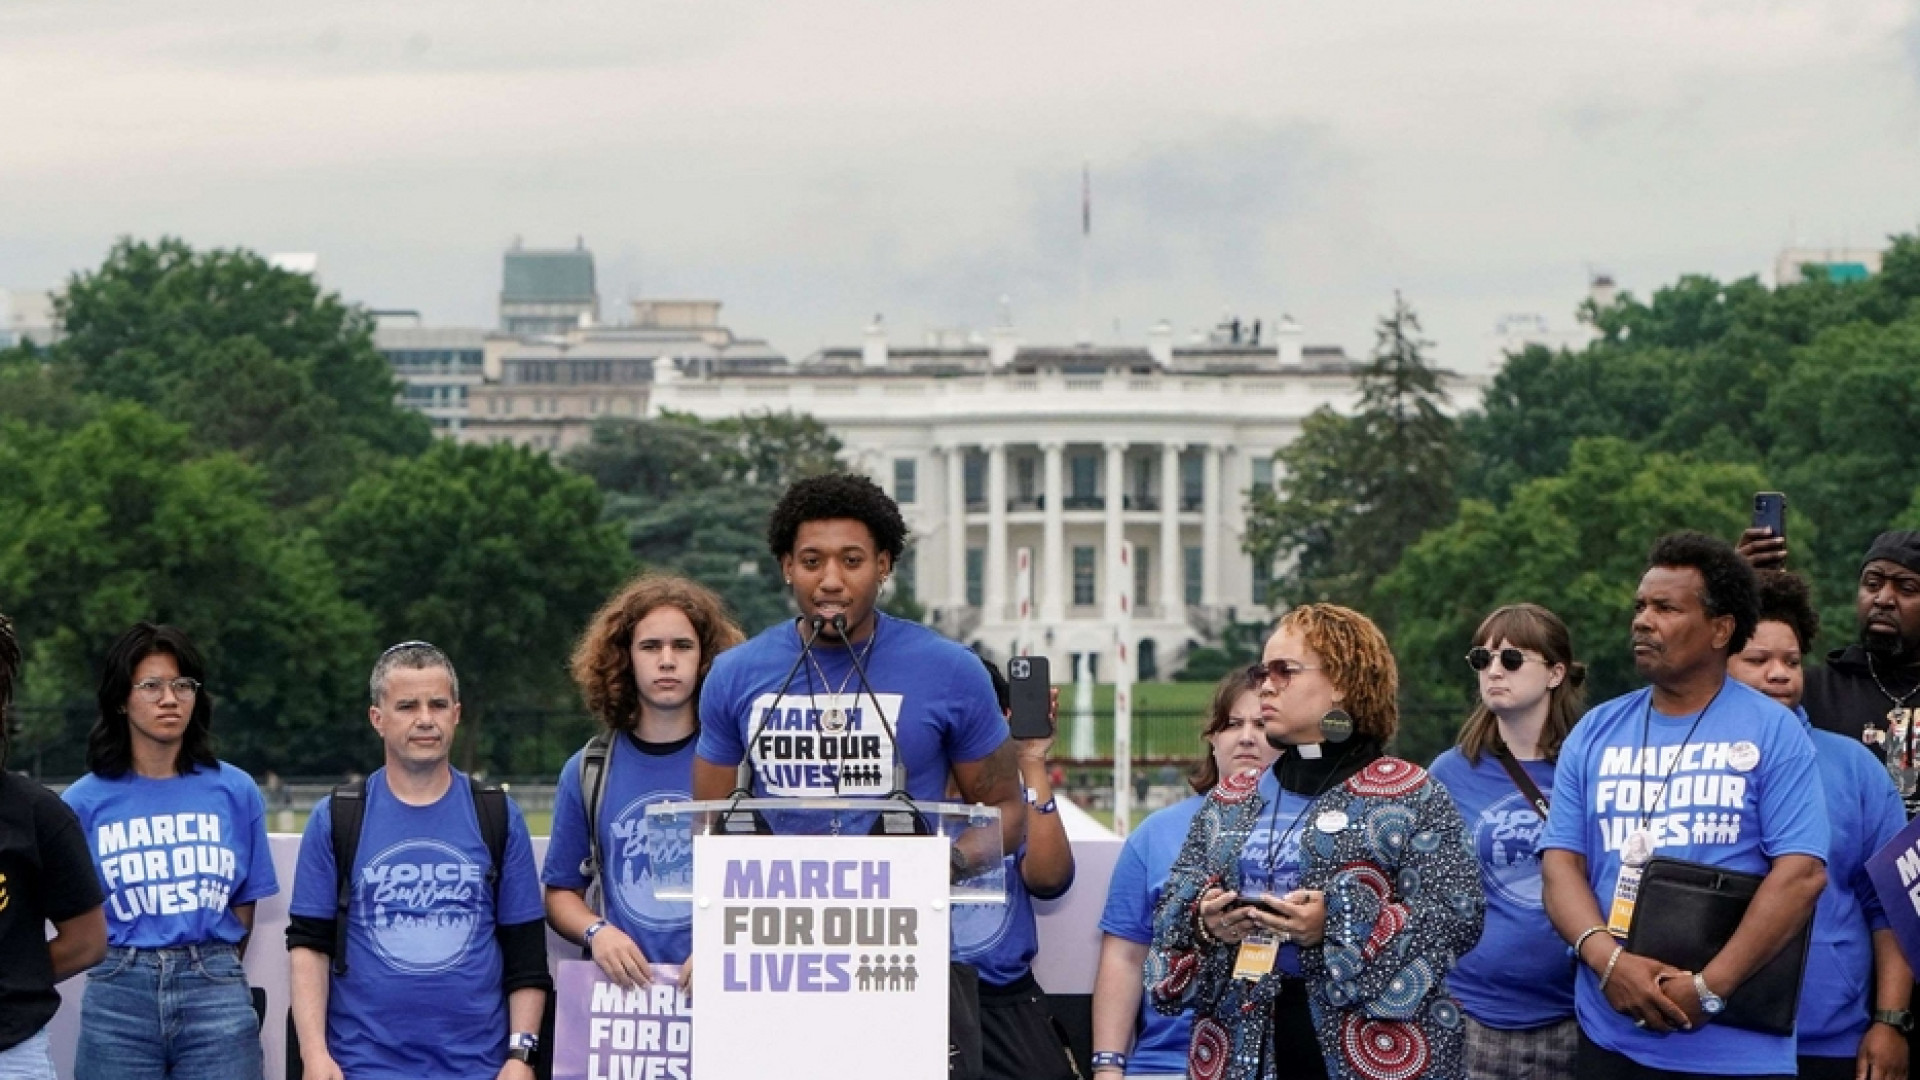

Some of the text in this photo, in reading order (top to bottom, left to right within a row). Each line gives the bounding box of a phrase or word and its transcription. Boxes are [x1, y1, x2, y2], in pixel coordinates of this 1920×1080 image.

[759, 708, 862, 730] MARH
[759, 736, 880, 760] FOR OUR
[1597, 775, 1746, 813] FOR OUR
[98, 813, 221, 857] MARCH
[101, 844, 235, 889] FOR OUR
[362, 863, 480, 883] VOICE
[723, 859, 890, 899] MARCH
[110, 879, 198, 922] LIVES
[723, 906, 918, 945] FOR OUR
[723, 953, 851, 992] LIVES
[590, 1018, 661, 1050] FOR
